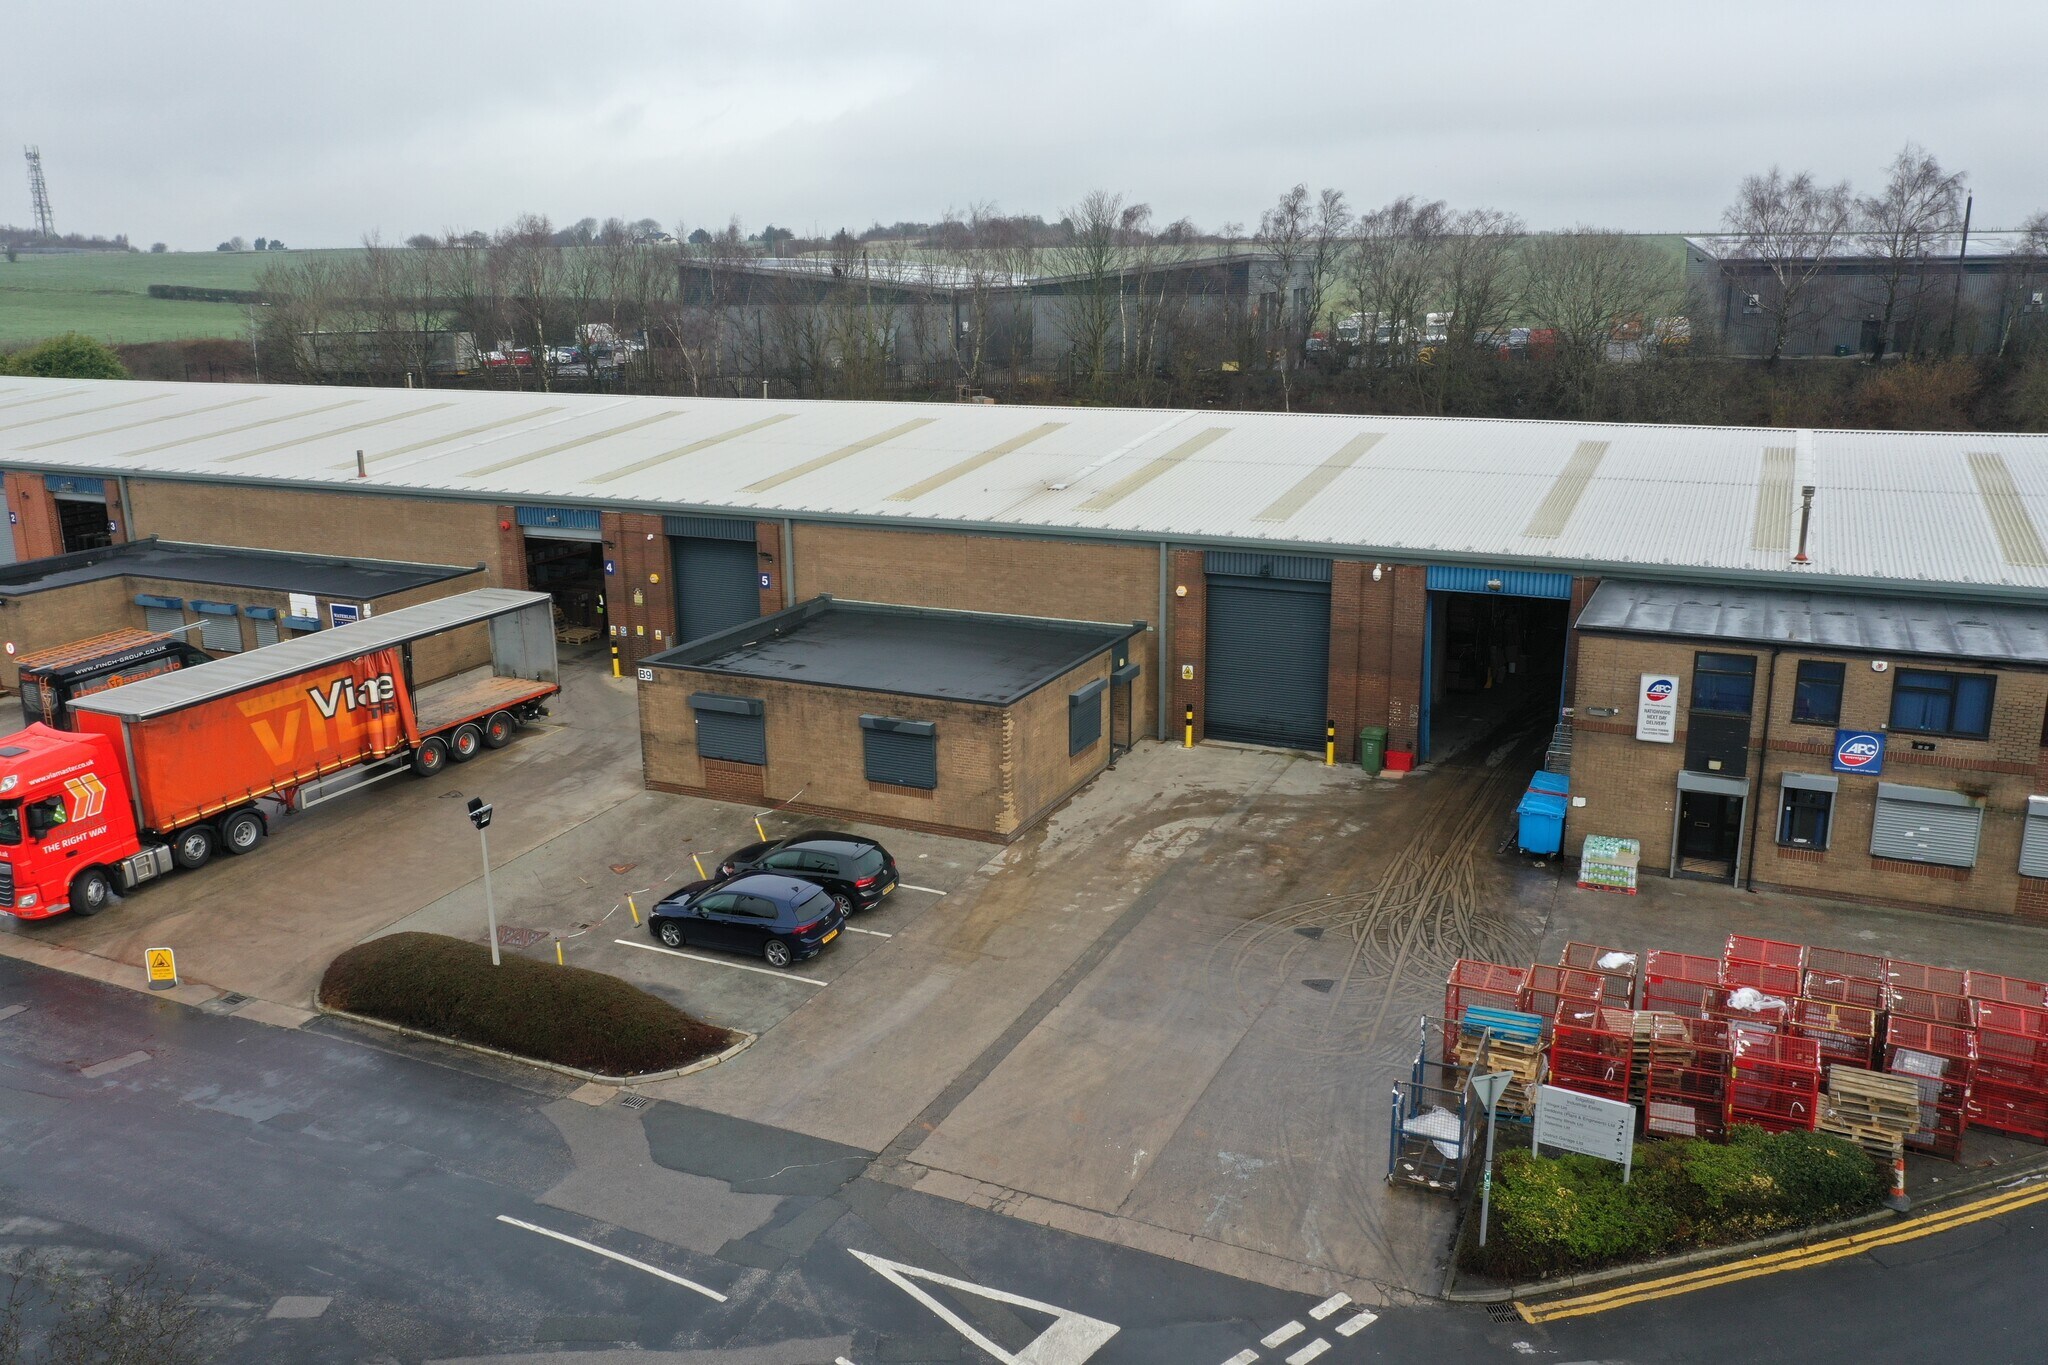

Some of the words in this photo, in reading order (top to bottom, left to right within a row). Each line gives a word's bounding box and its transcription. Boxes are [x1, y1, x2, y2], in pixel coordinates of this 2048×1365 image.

[606, 562, 613, 573] 4
[761, 575, 768, 586] 5
[163, 661, 181, 673] LTD
[640, 669, 652, 680] B9
[1651, 684, 1671, 692] APC
[1846, 743, 1876, 755] APC
[29, 760, 94, 785] www.viamaster.co.uk
[42, 841, 61, 855] THE
[61, 831, 88, 848] RIGHT
[88, 825, 107, 839] WAY
